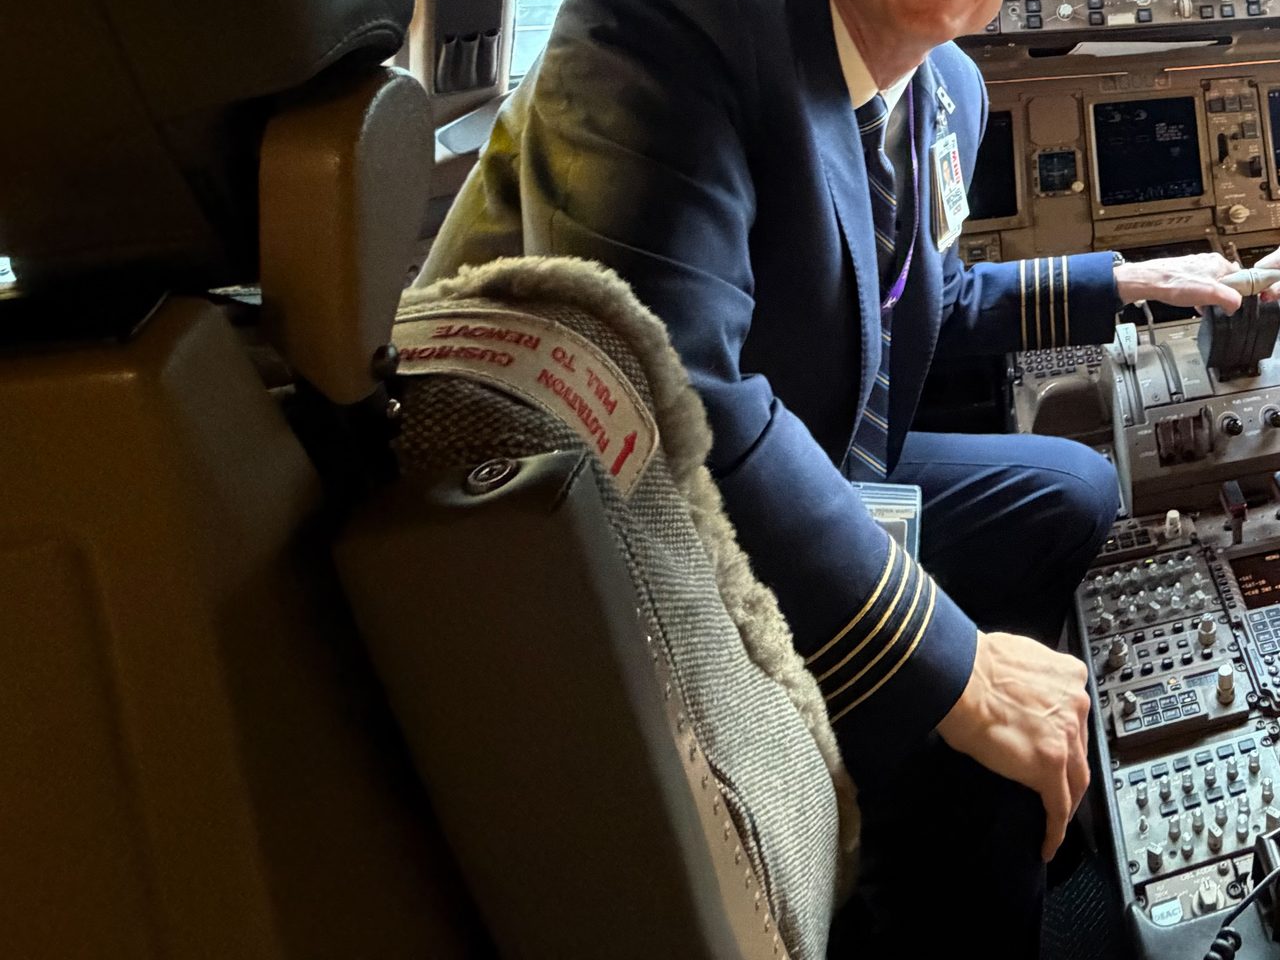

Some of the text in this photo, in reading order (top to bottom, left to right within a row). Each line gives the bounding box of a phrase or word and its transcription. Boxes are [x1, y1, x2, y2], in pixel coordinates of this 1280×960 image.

[1114, 215, 1194, 232] BOEING 777
[432, 325, 618, 415] PULL TO REMOVE
